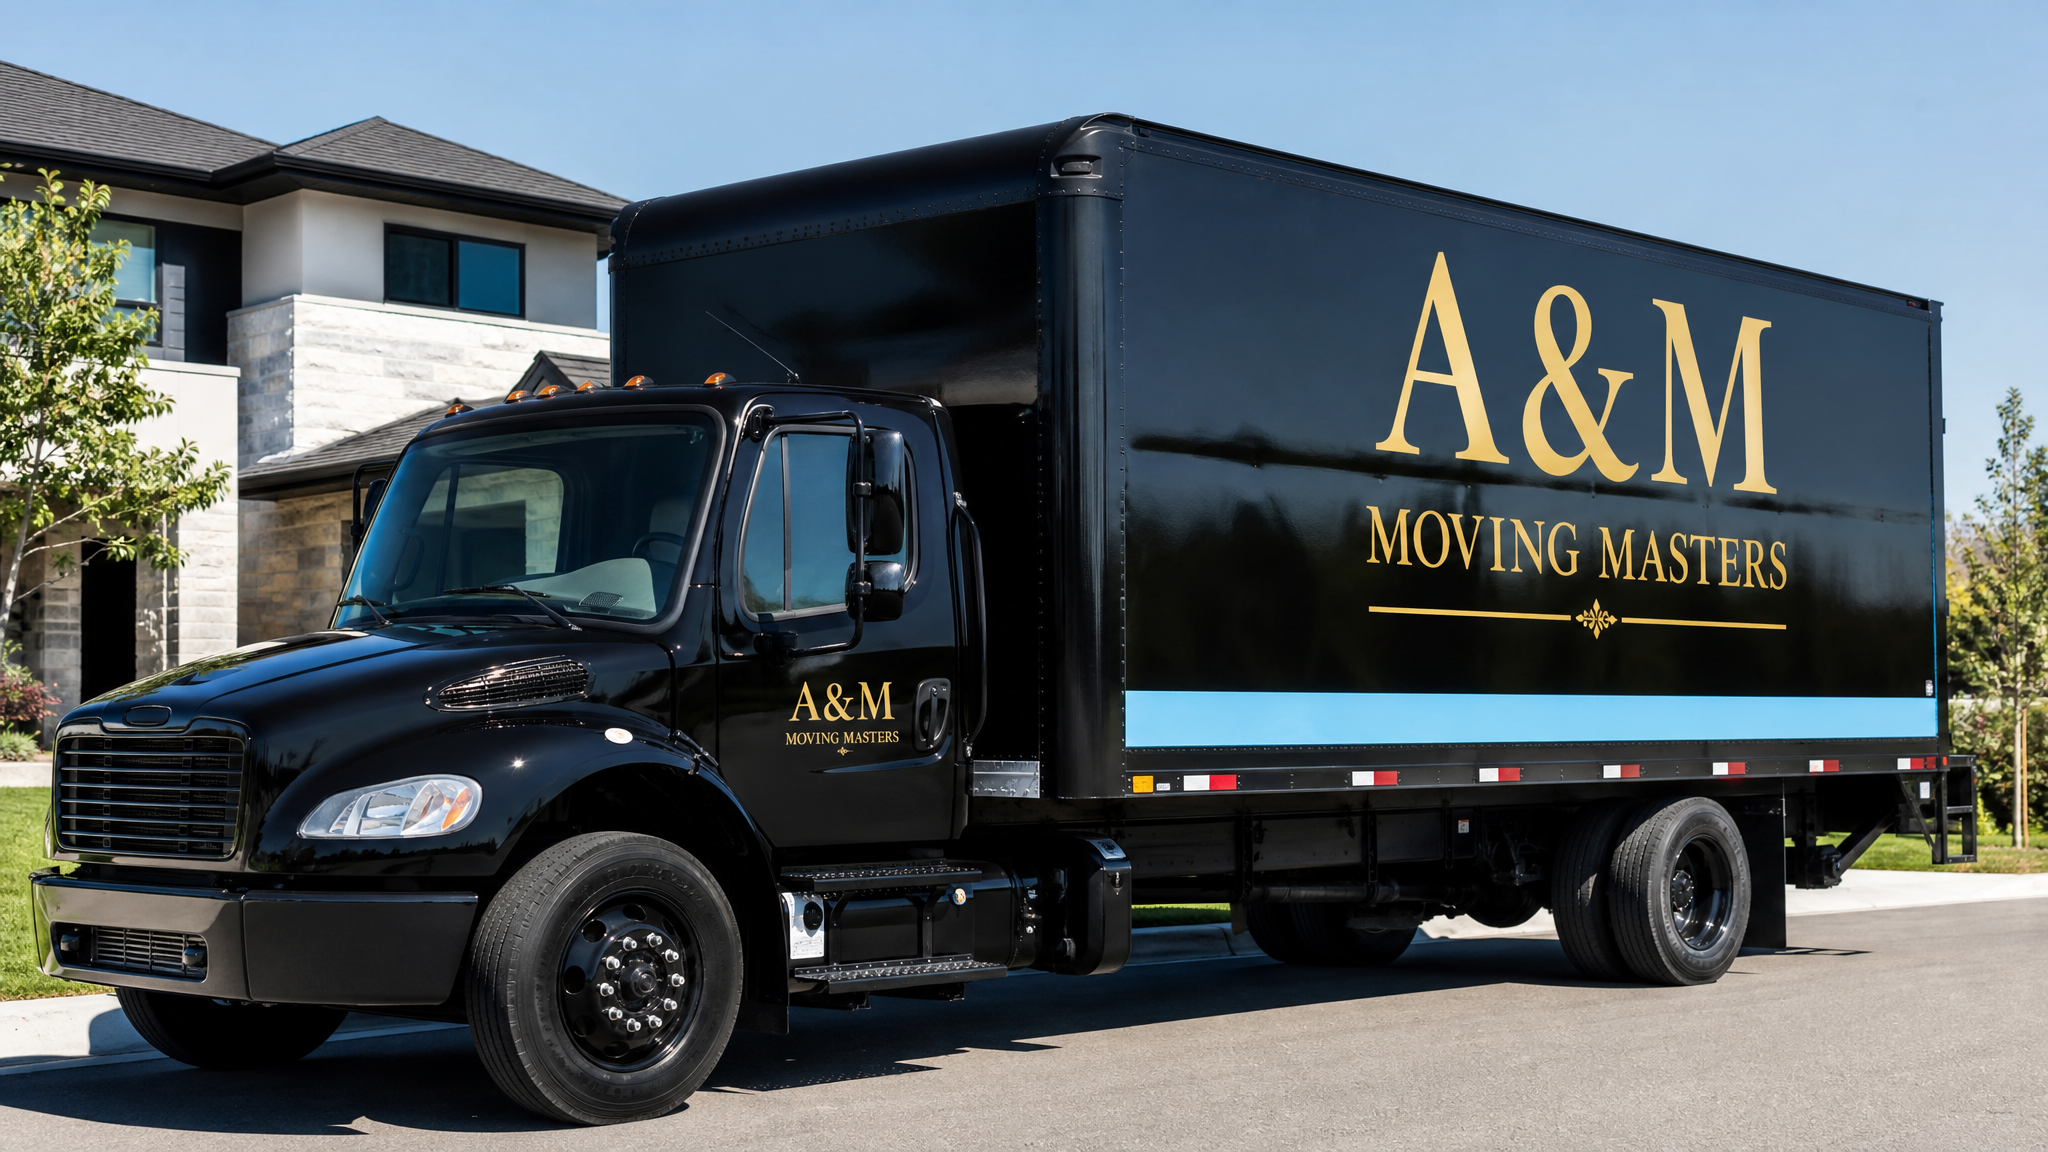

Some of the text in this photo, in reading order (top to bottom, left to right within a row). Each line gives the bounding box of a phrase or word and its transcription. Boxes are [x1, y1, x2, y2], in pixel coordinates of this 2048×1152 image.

[1375, 251, 1778, 495] A&M
[1365, 505, 1788, 591] MOVING MASTERS
[788, 680, 896, 722] A&M
[785, 730, 900, 746] MOVING MASTERS
